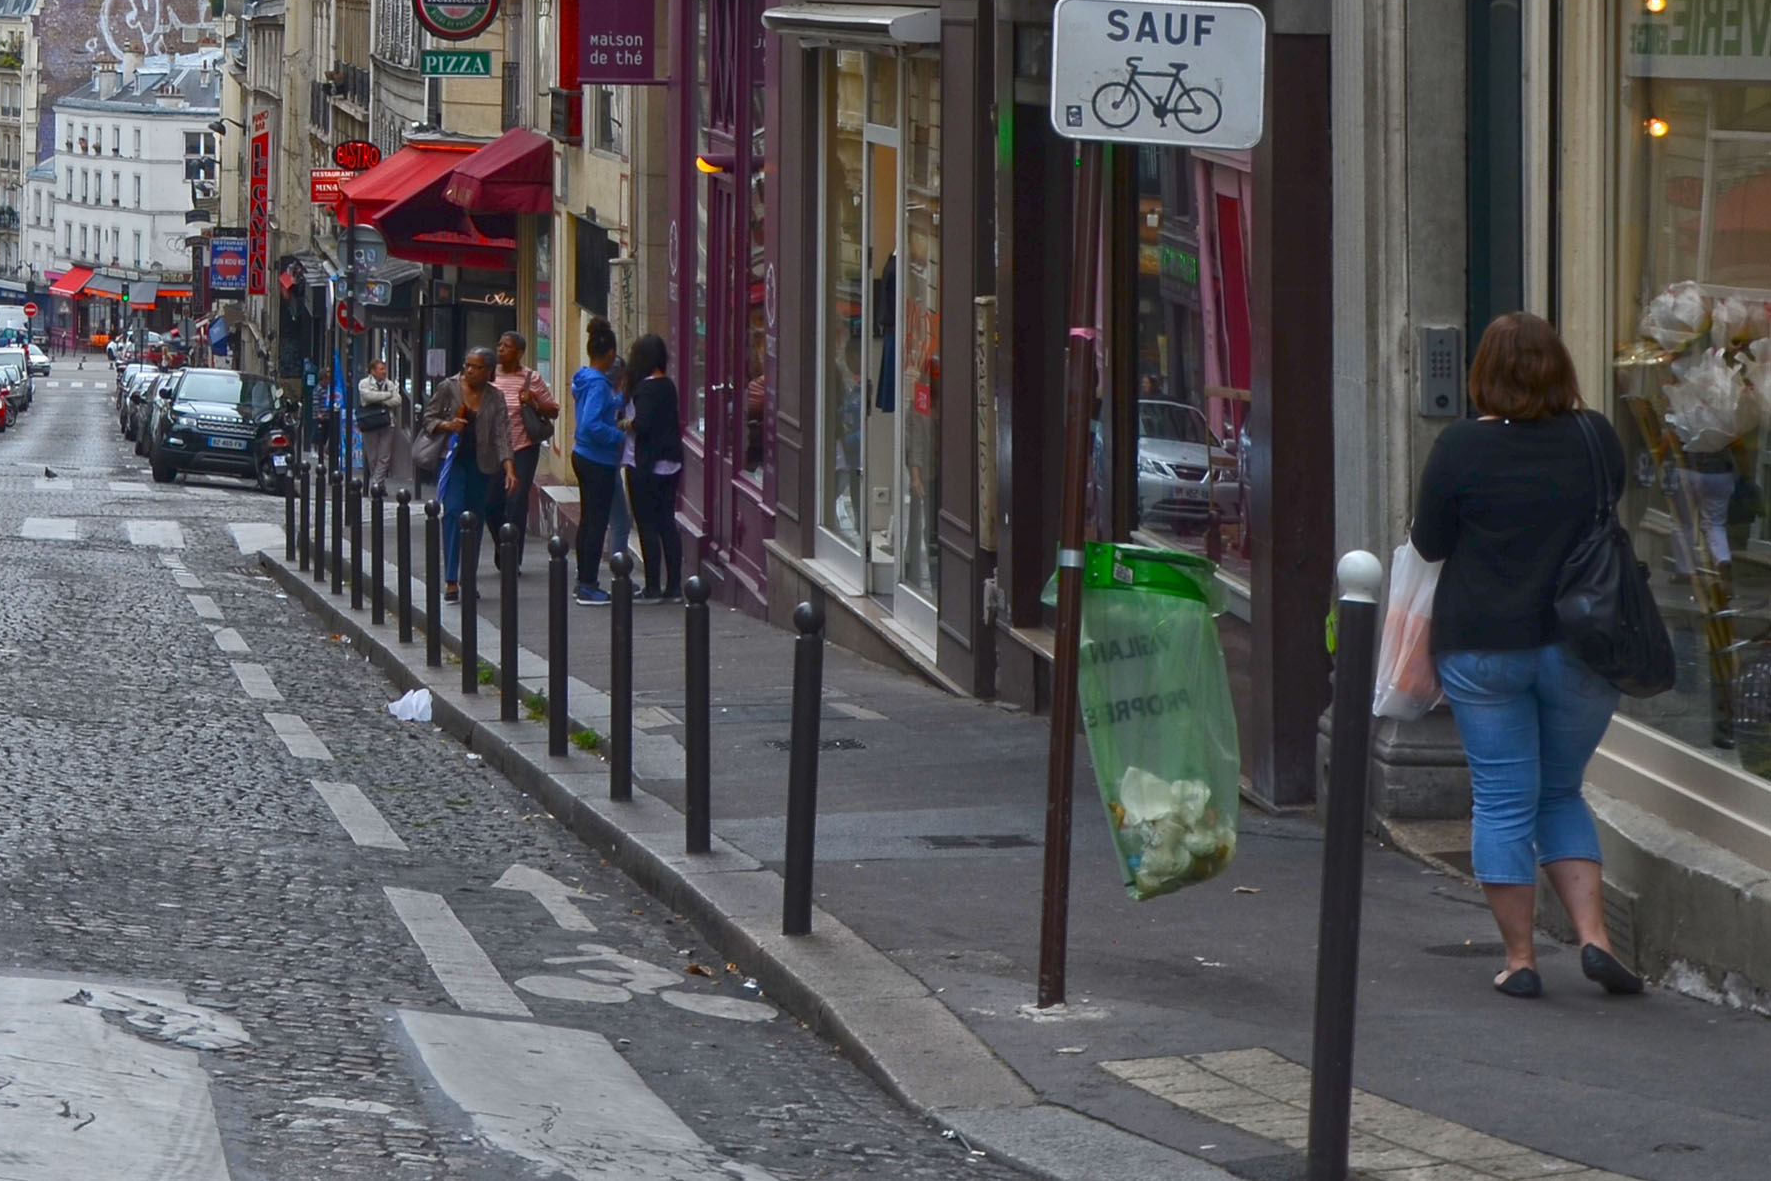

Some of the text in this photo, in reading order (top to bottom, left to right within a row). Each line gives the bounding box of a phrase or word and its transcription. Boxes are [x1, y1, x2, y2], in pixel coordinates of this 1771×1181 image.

[1106, 9, 1216, 47] SAUF
[424, 55, 487, 74] PIZZA
[590, 49, 643, 65] de thé
[336, 142, 380, 169] BISTRO
[315, 184, 339, 192] MINA
[251, 184, 267, 290] CAVEAU
